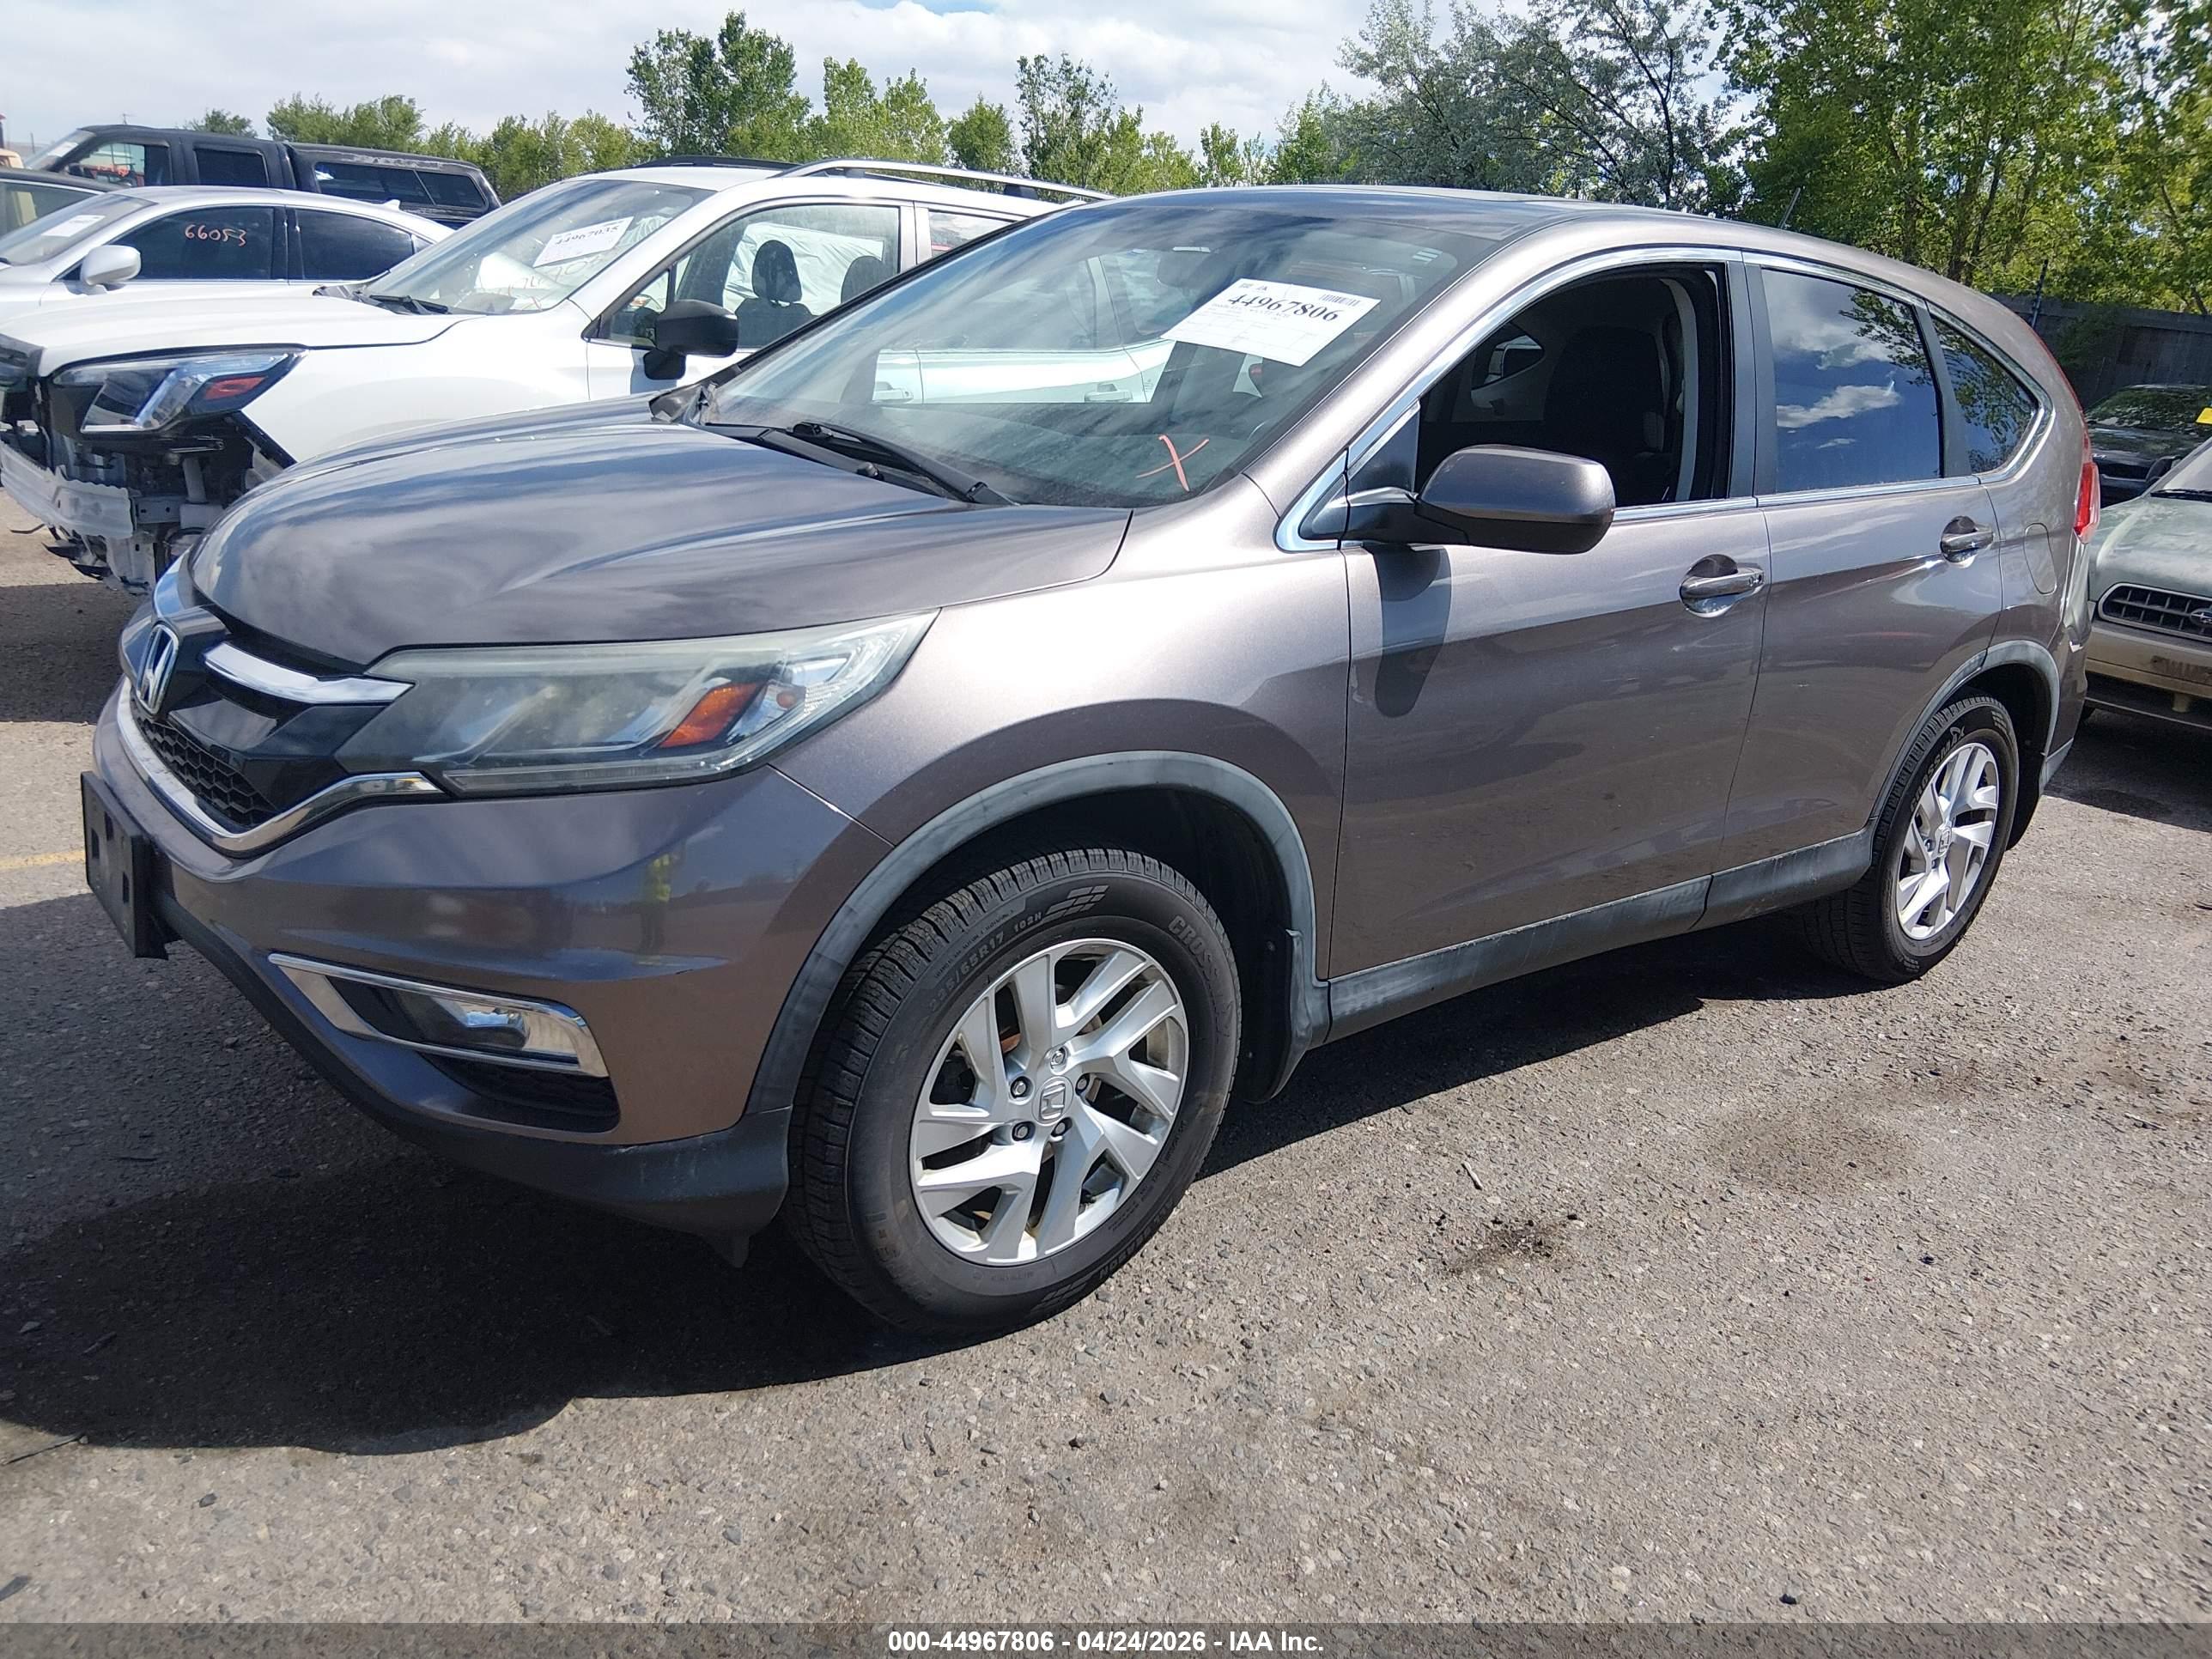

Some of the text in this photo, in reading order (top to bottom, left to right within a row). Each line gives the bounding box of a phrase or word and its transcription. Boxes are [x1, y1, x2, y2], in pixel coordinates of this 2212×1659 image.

[185, 223, 247, 247] 66053
[1227, 293, 1346, 322] 44967806
[1013, 910, 1042, 933] 102H
